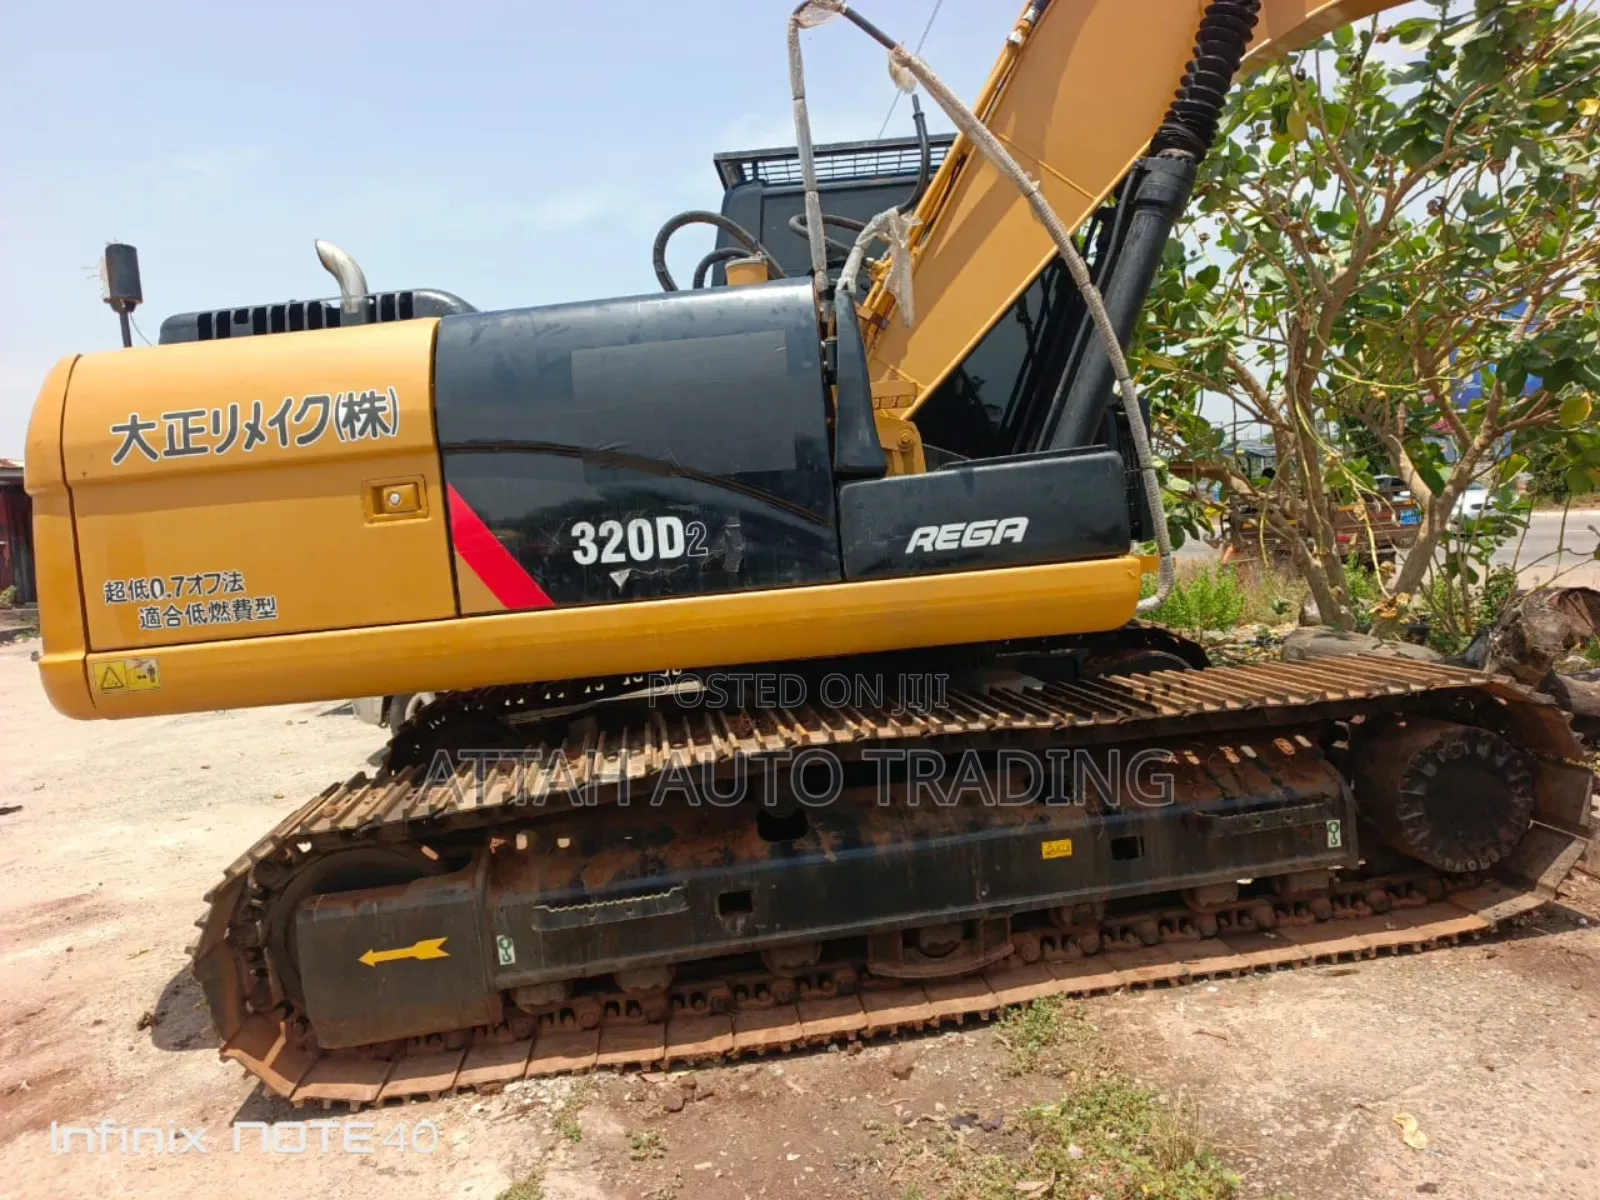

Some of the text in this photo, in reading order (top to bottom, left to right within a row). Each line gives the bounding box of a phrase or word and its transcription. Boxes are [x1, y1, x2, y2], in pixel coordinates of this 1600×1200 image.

[110, 387, 398, 465] 大正リメイク(株)
[904, 516, 1030, 555] REGA
[139, 596, 277, 629] 適合低燃費型
